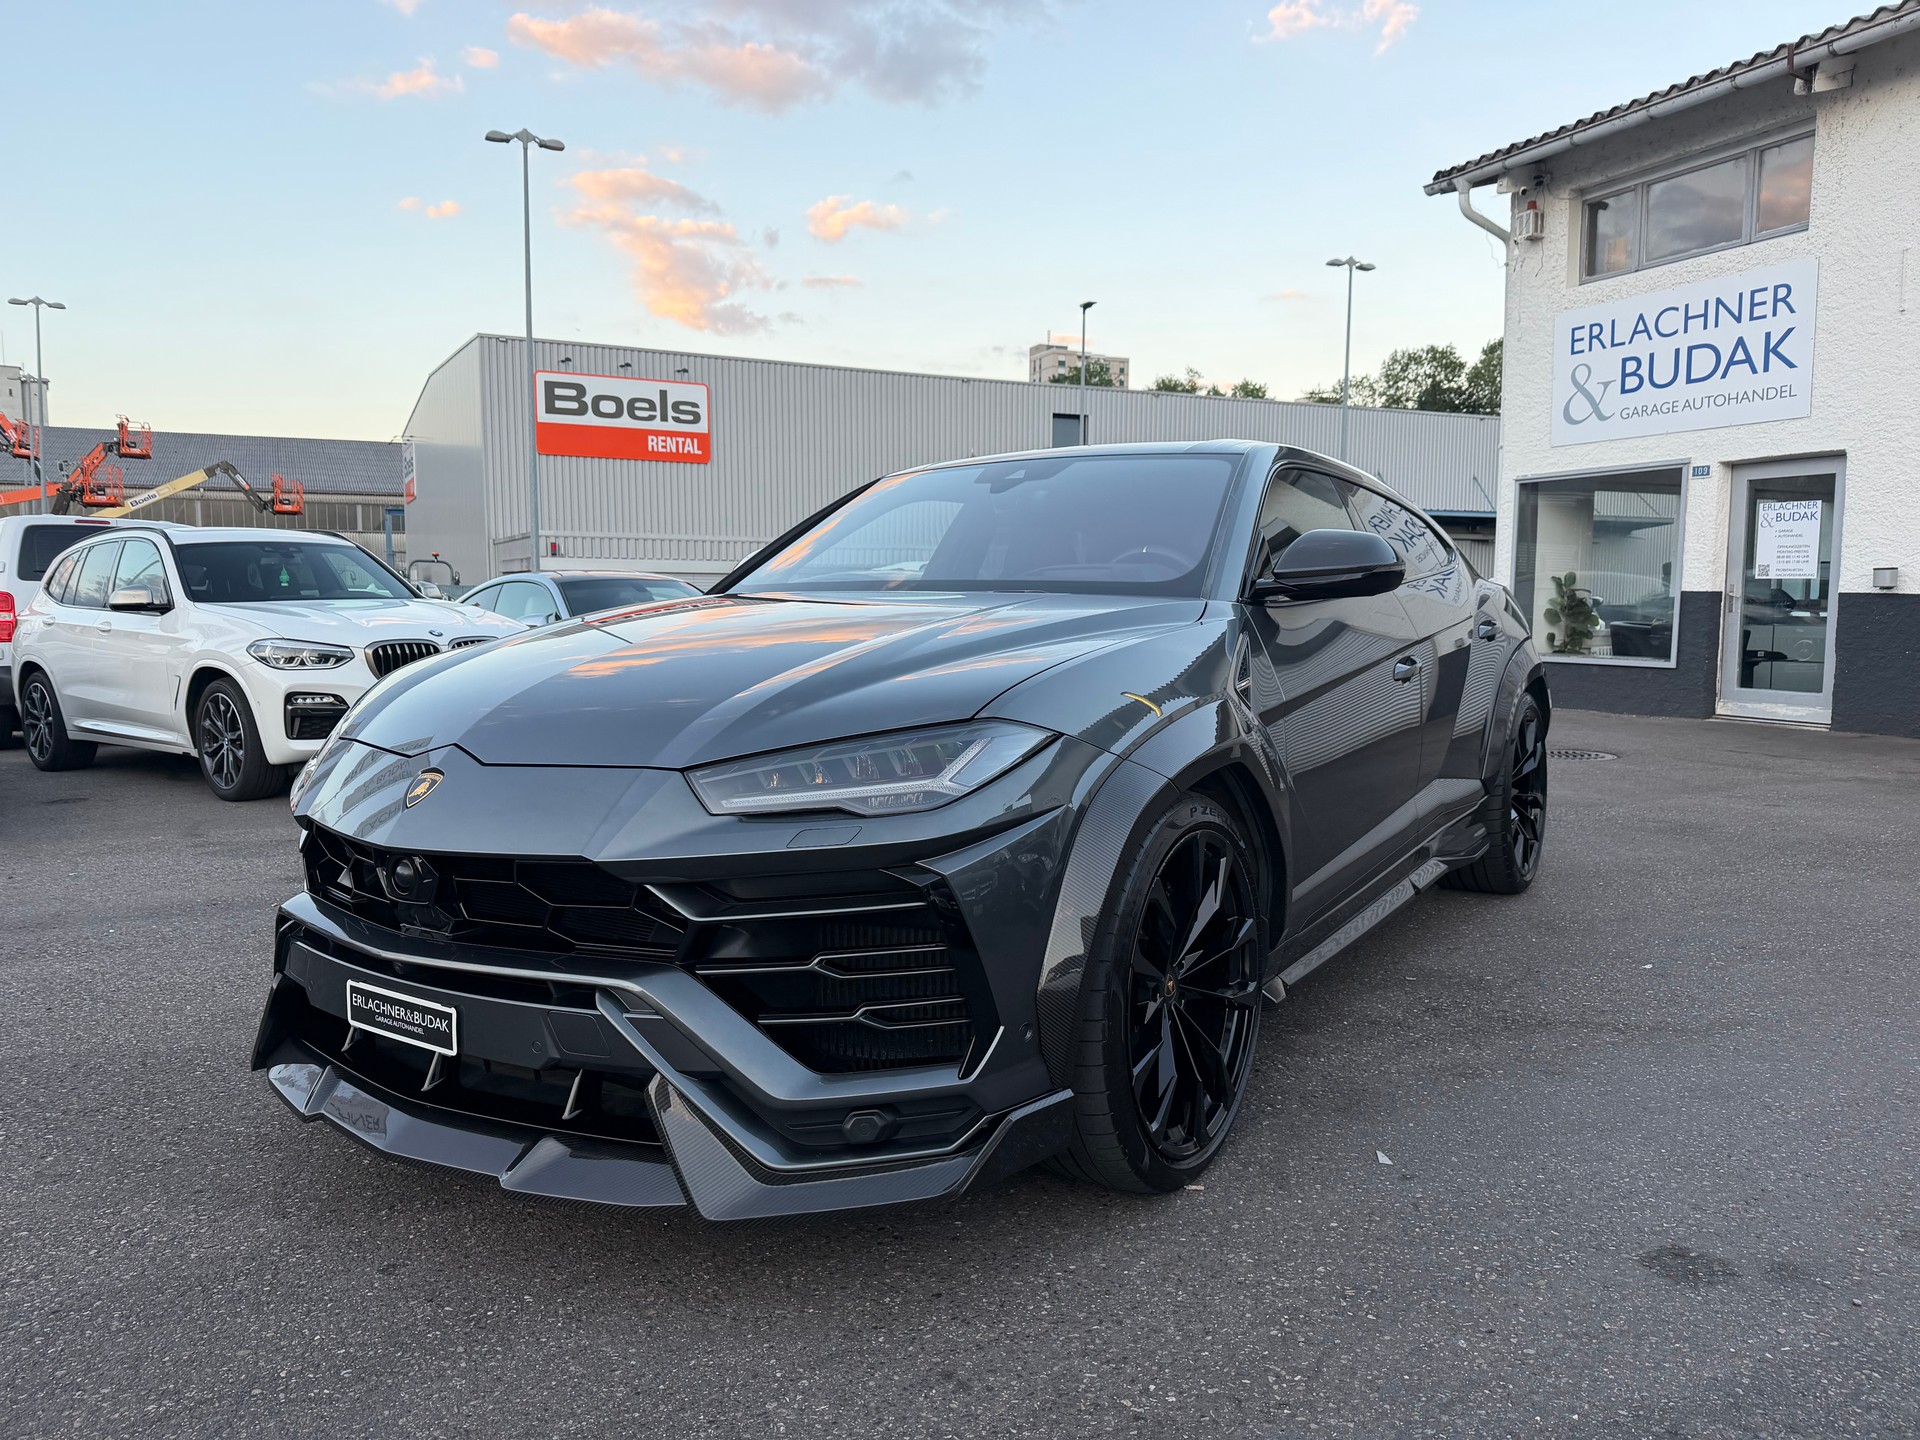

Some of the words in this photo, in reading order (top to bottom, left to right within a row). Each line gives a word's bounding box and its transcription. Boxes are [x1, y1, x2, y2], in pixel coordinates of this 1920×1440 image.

[1570, 283, 1797, 355] ERLACHNER
[1562, 363, 1616, 425] &
[1620, 326, 1798, 395] BUDAK
[544, 380, 701, 425] Boels
[1620, 401, 1679, 420] GARAGE
[1681, 384, 1797, 411] AUTOHANDEL
[647, 435, 702, 454] RENTAL
[1695, 466, 1708, 475] 109
[1762, 501, 1818, 511] ERLACHNER
[1776, 511, 1818, 522] BUDAK
[375, 1015, 392, 1025] GARAGE
[393, 1020, 424, 1034] AUTOHANDEL
